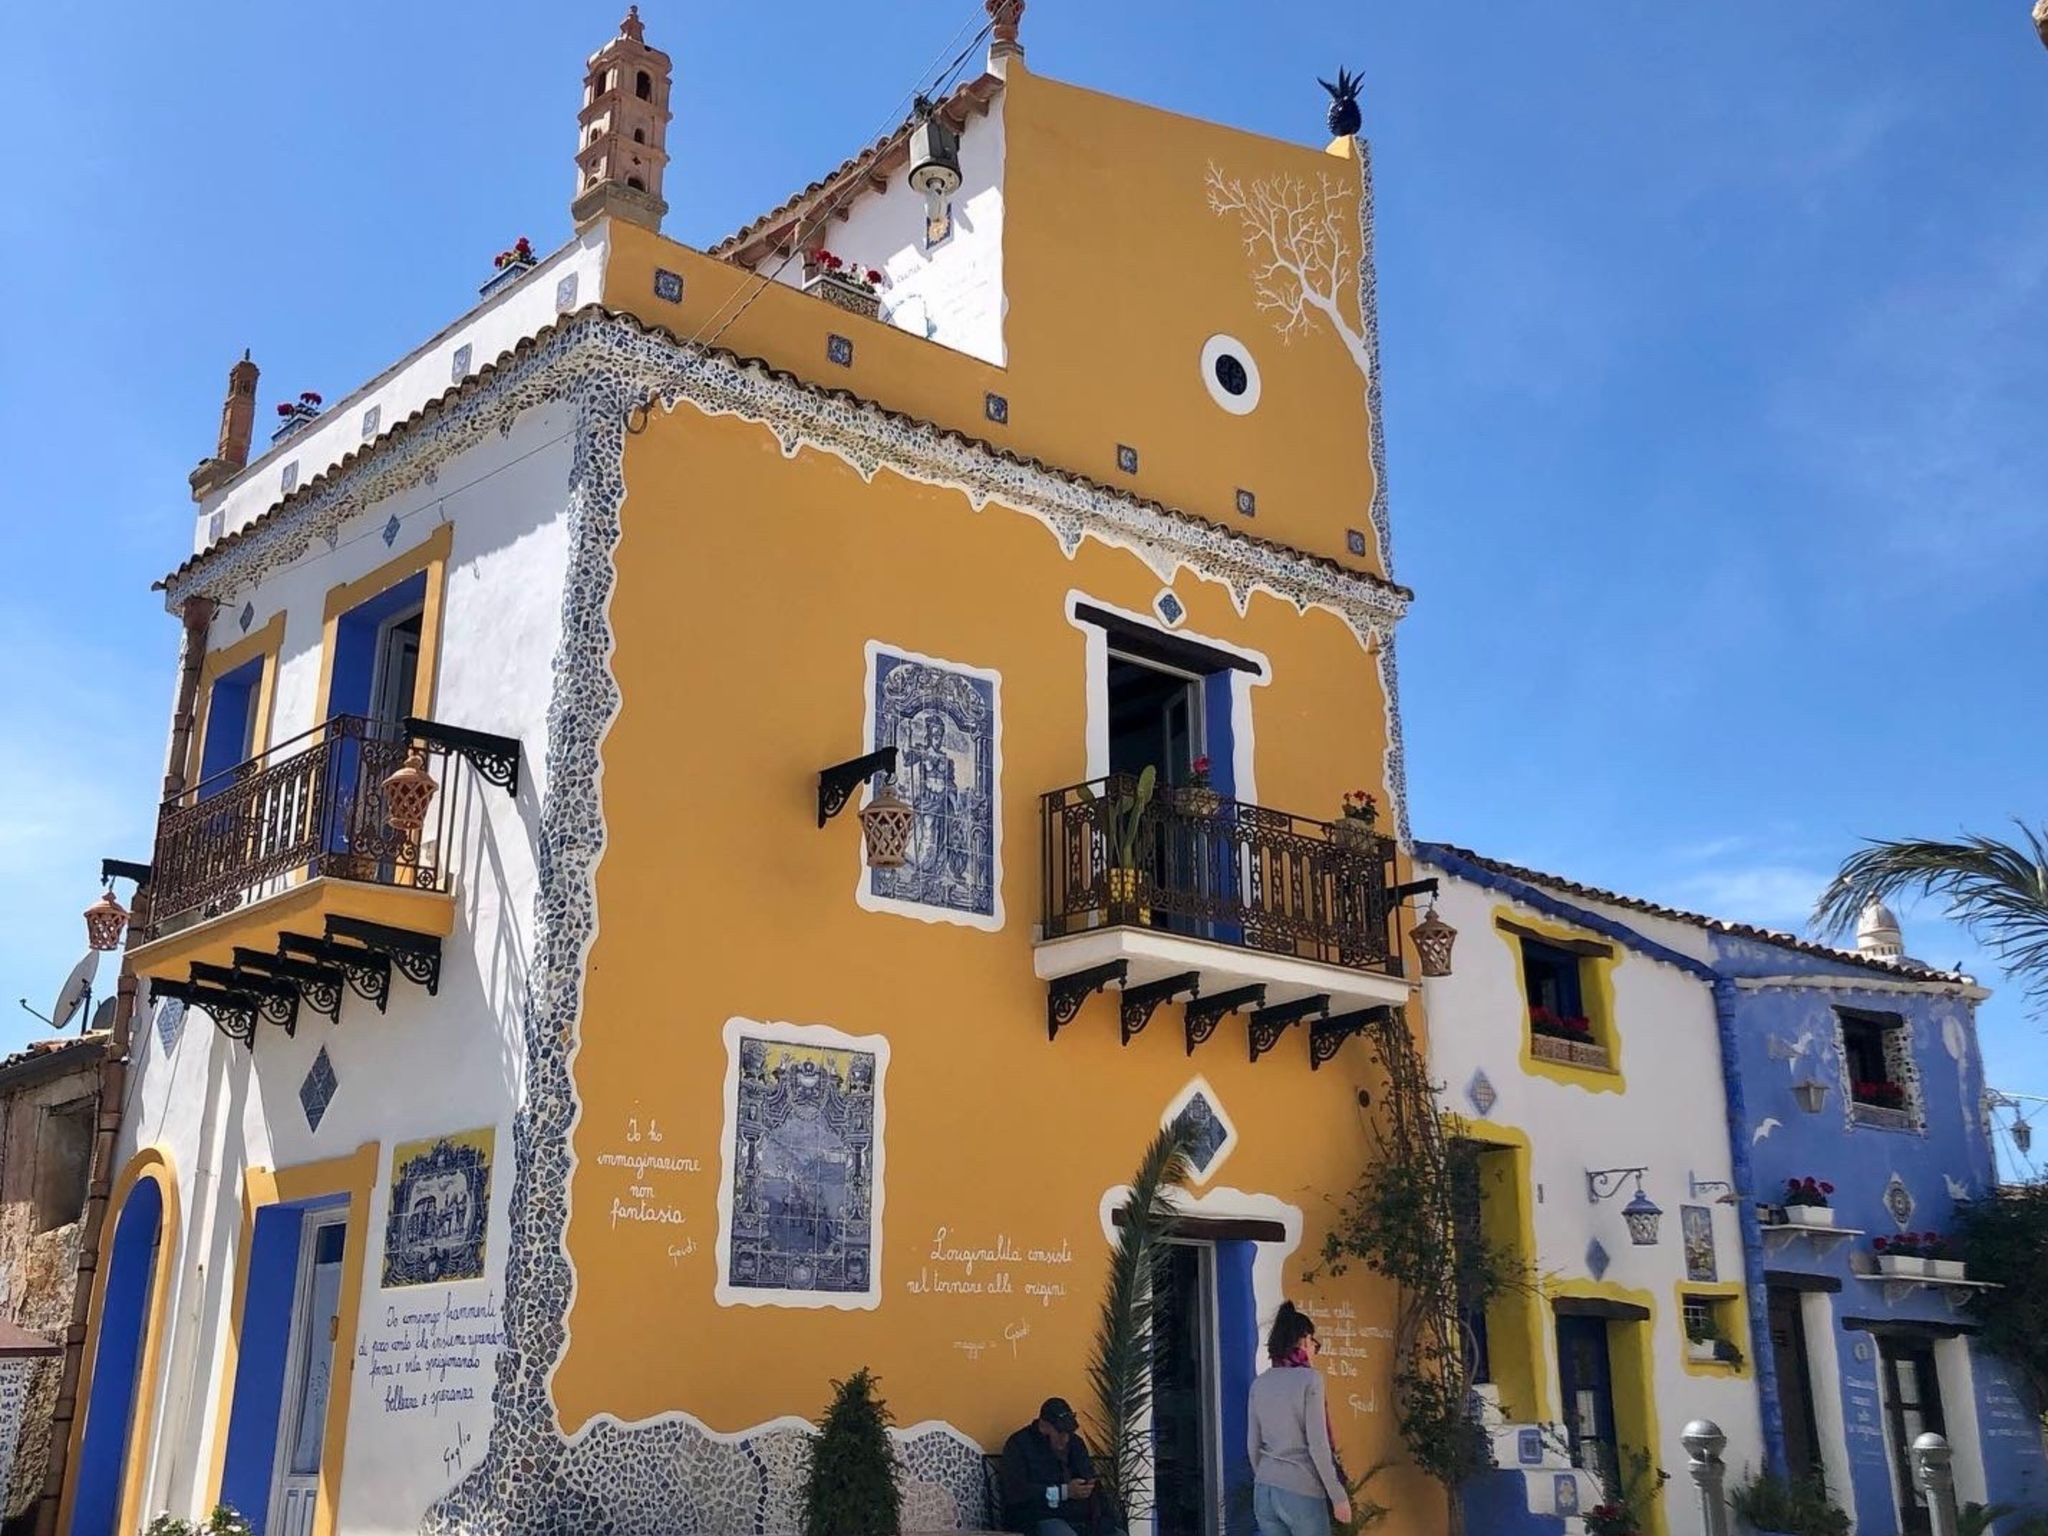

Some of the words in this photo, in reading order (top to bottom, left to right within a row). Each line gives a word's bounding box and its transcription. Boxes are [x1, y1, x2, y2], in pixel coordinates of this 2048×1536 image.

[629, 1183, 656, 1198] non
[610, 1198, 685, 1232] fantasia
[1027, 1238, 1073, 1263] consiste
[906, 1267, 931, 1294] nel
[933, 1270, 983, 1294] tornare
[1024, 1282, 1067, 1307] origini
[443, 1289, 497, 1334] frammenti
